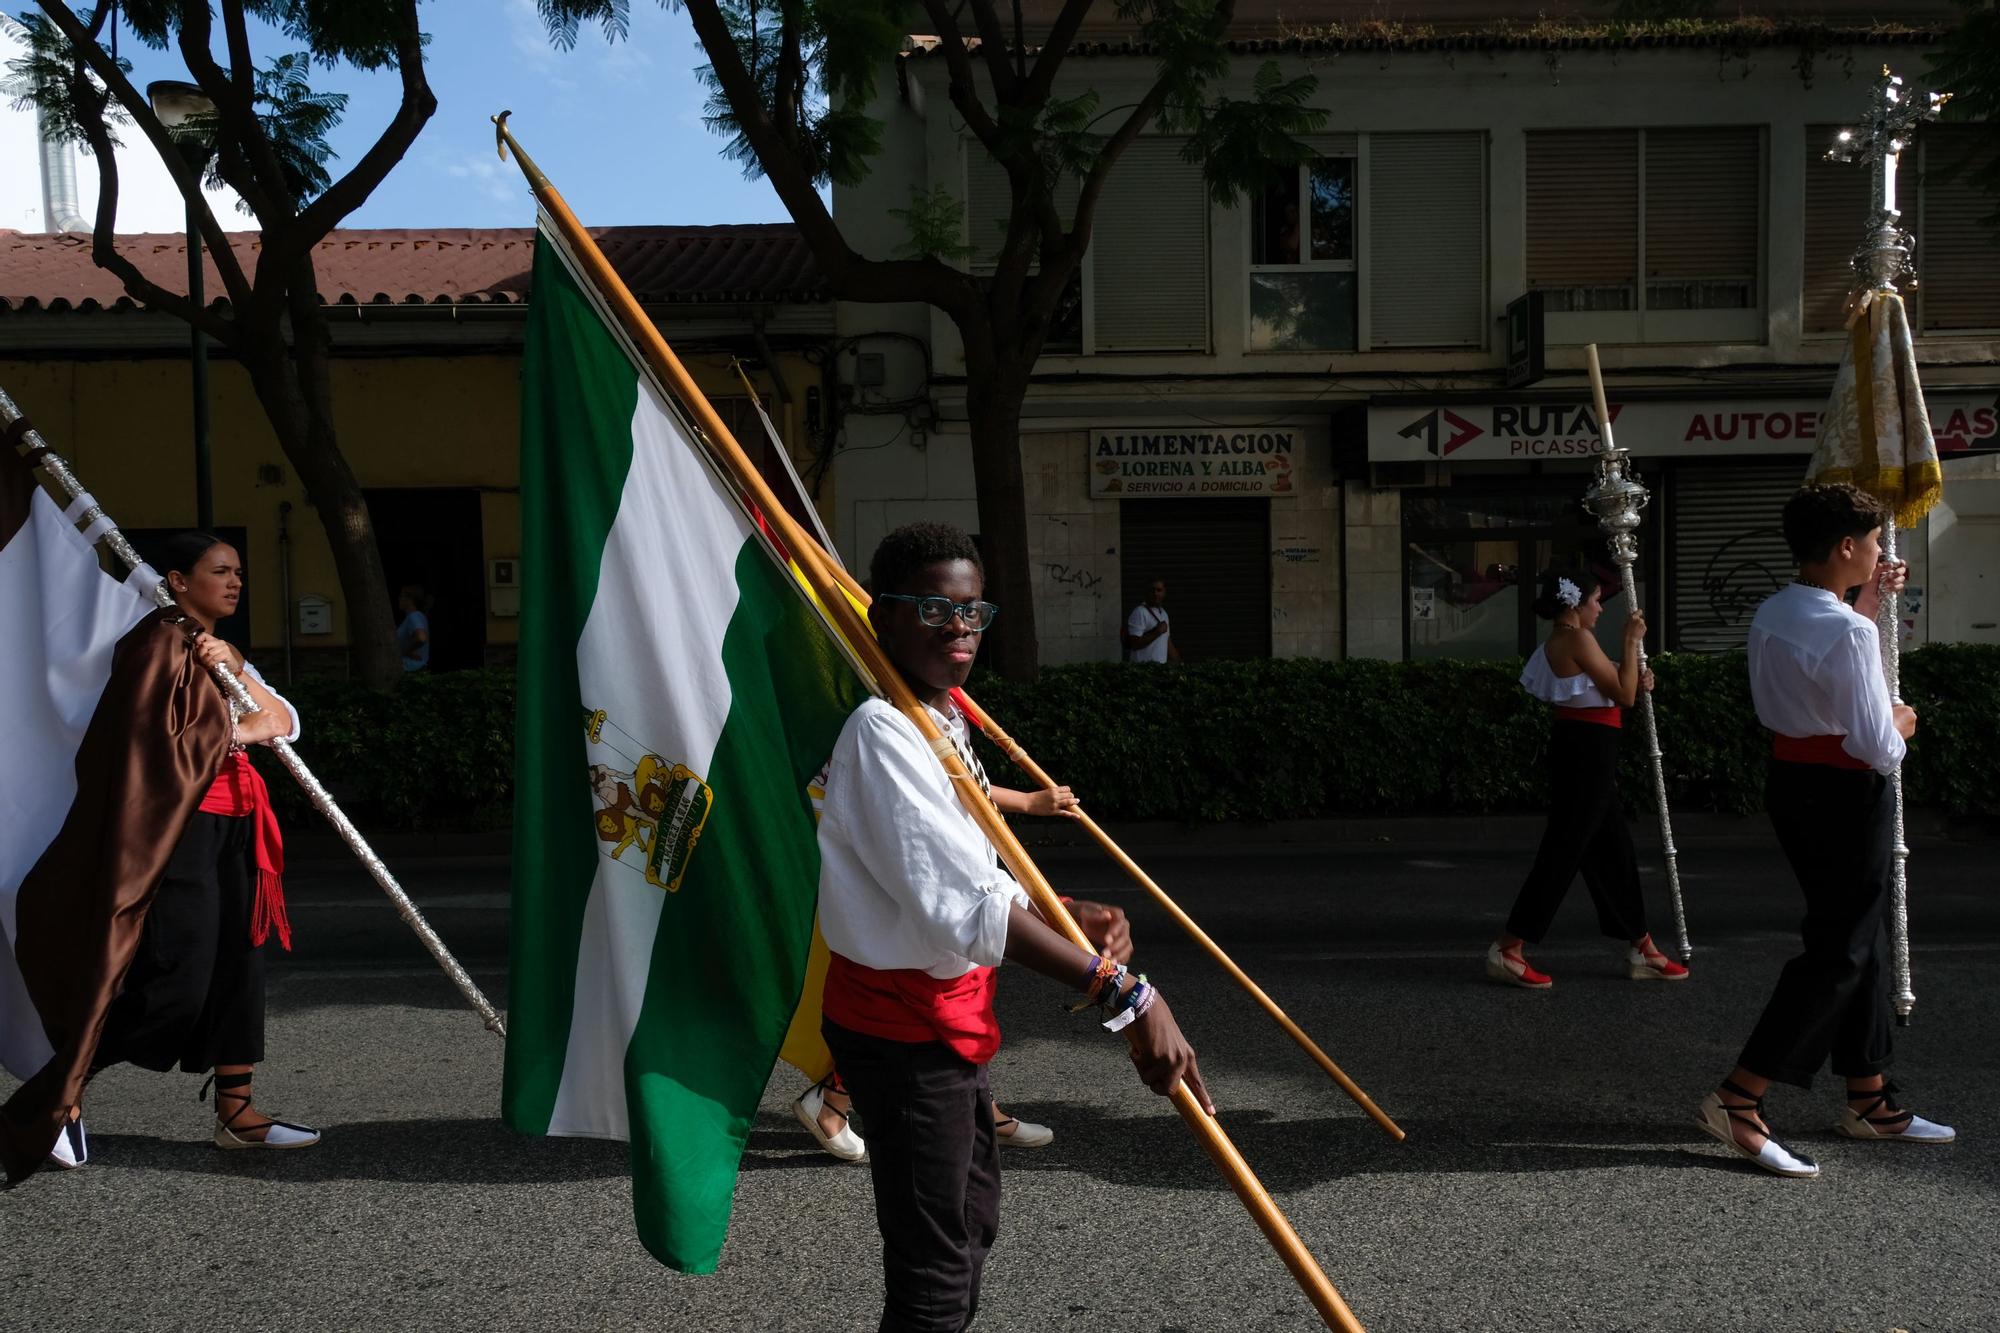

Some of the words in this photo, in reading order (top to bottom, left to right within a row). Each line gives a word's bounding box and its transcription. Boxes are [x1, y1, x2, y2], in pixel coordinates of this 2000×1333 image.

[1096, 433, 1293, 456] ALIMENTACION
[1122, 461, 1195, 477] LORENA
[1200, 461, 1213, 476] Y
[1218, 460, 1267, 476] ALBA
[1127, 482, 1183, 493] SERVICIO
[1187, 482, 1196, 492] A
[1201, 481, 1263, 492] DOMICILIO
